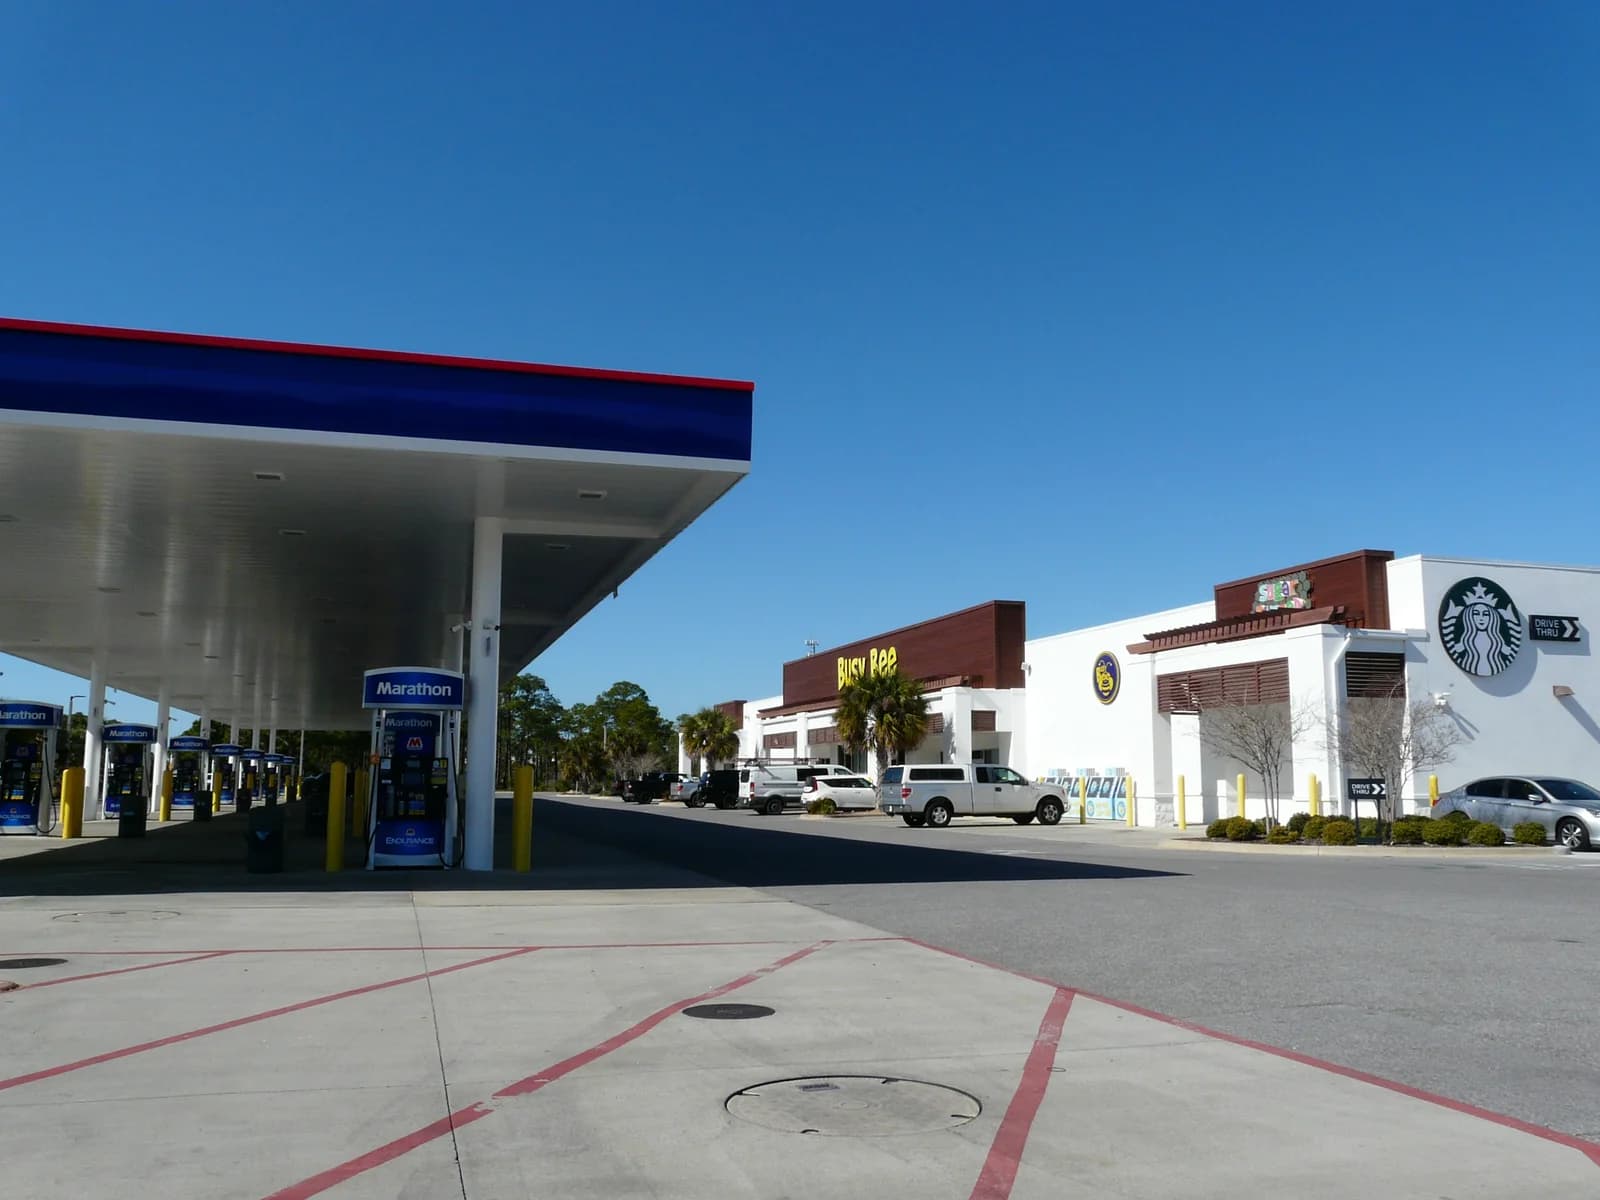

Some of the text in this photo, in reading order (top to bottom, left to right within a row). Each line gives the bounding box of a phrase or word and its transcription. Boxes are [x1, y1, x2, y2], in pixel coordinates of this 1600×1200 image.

[1535, 619, 1560, 628] DRIVE
[1536, 628, 1559, 637] THRU
[376, 681, 452, 697] Marathon
[385, 717, 433, 728] Marathon
[386, 836, 434, 845] ENDURANCE
